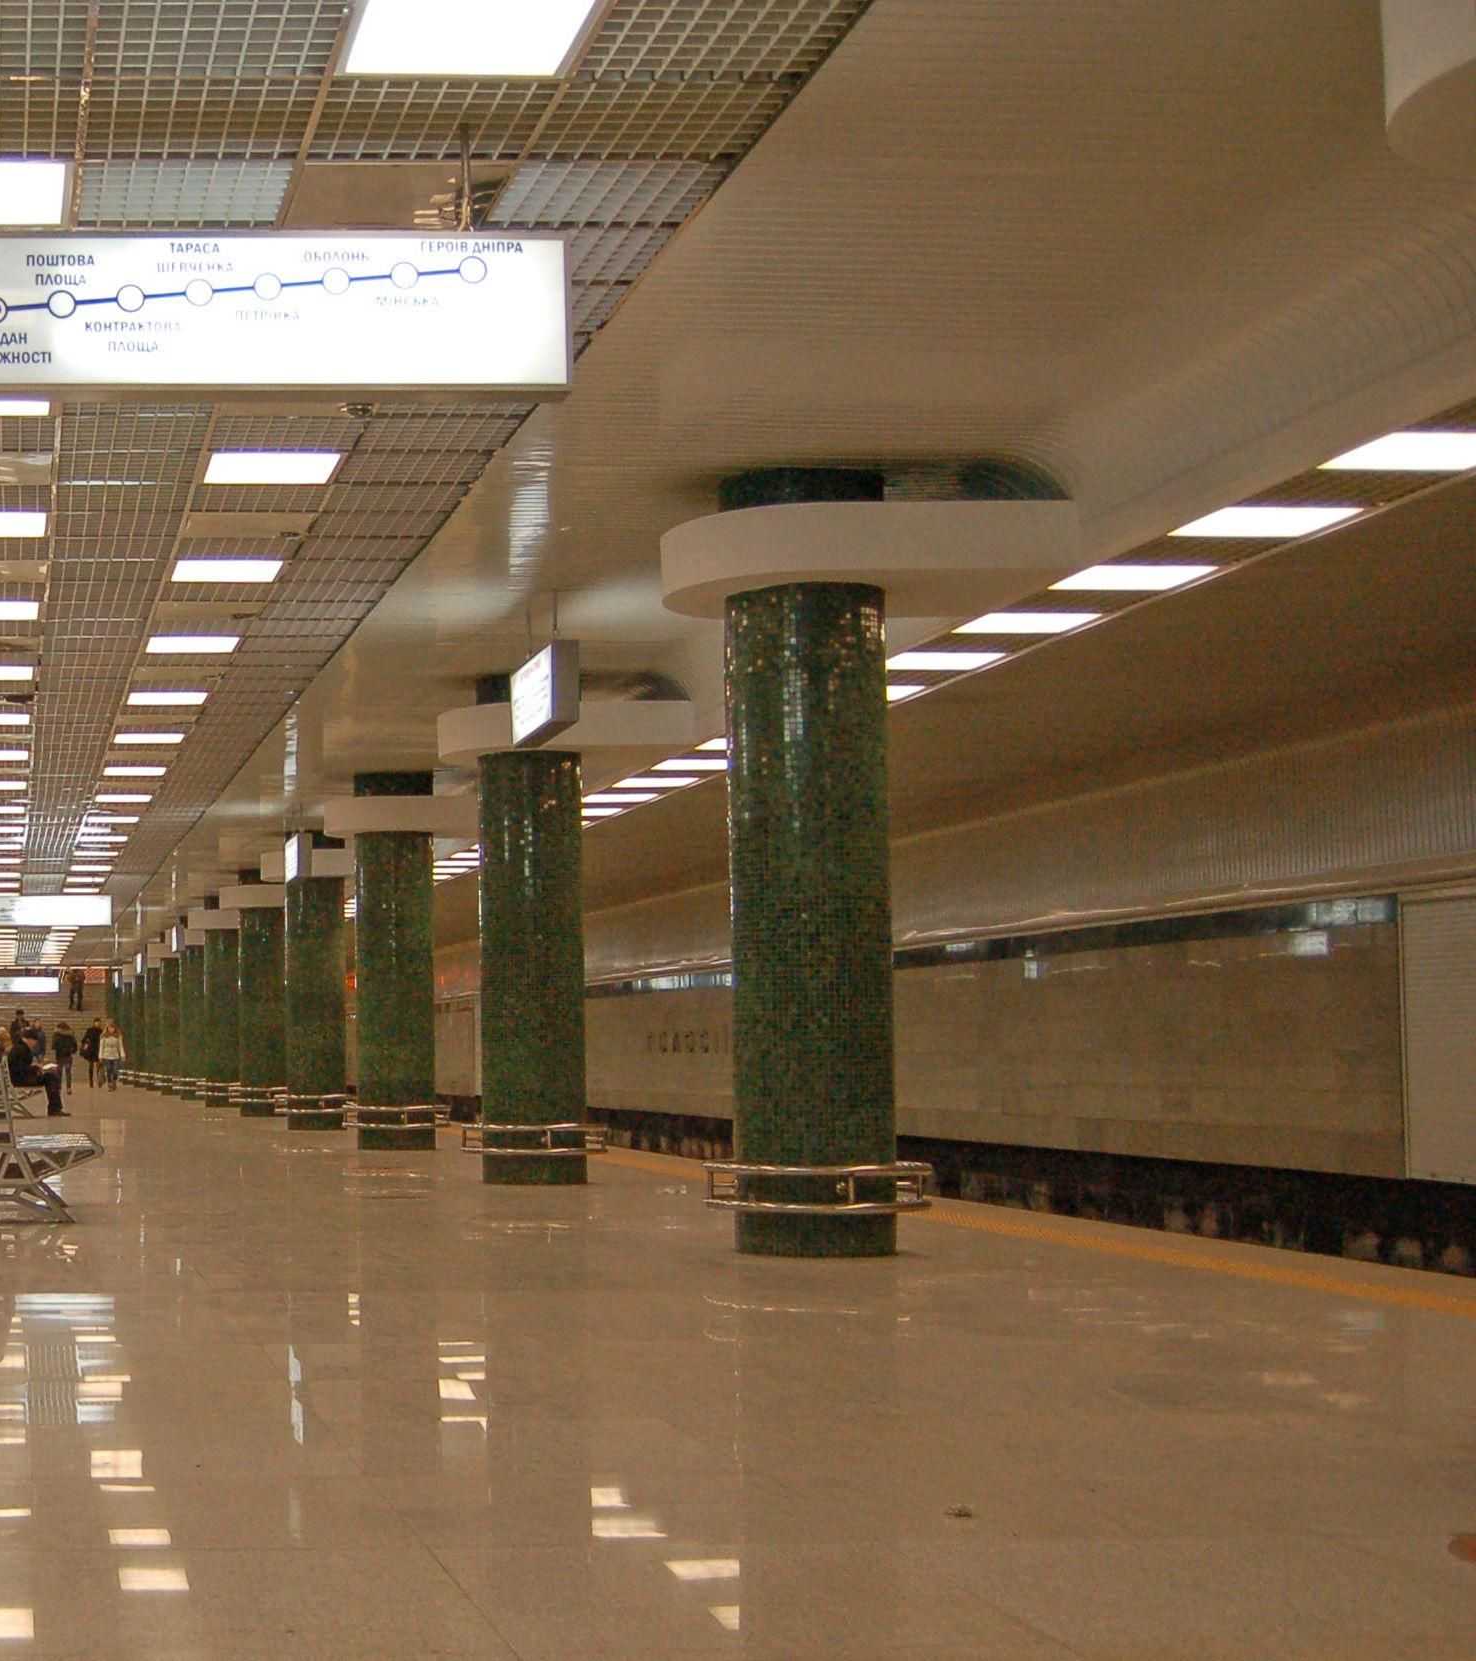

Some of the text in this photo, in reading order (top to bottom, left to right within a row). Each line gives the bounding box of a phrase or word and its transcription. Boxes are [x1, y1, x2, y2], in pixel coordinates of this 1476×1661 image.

[170, 242, 220, 254] ТАРАСА
[472, 241, 523, 254] ДНІПРА
[26, 254, 95, 267] ПОШТОВА
[303, 250, 370, 261] ОБОЛОНЬ
[35, 273, 86, 286] ПЛОЩА
[108, 340, 159, 353] ПЛОЩА
